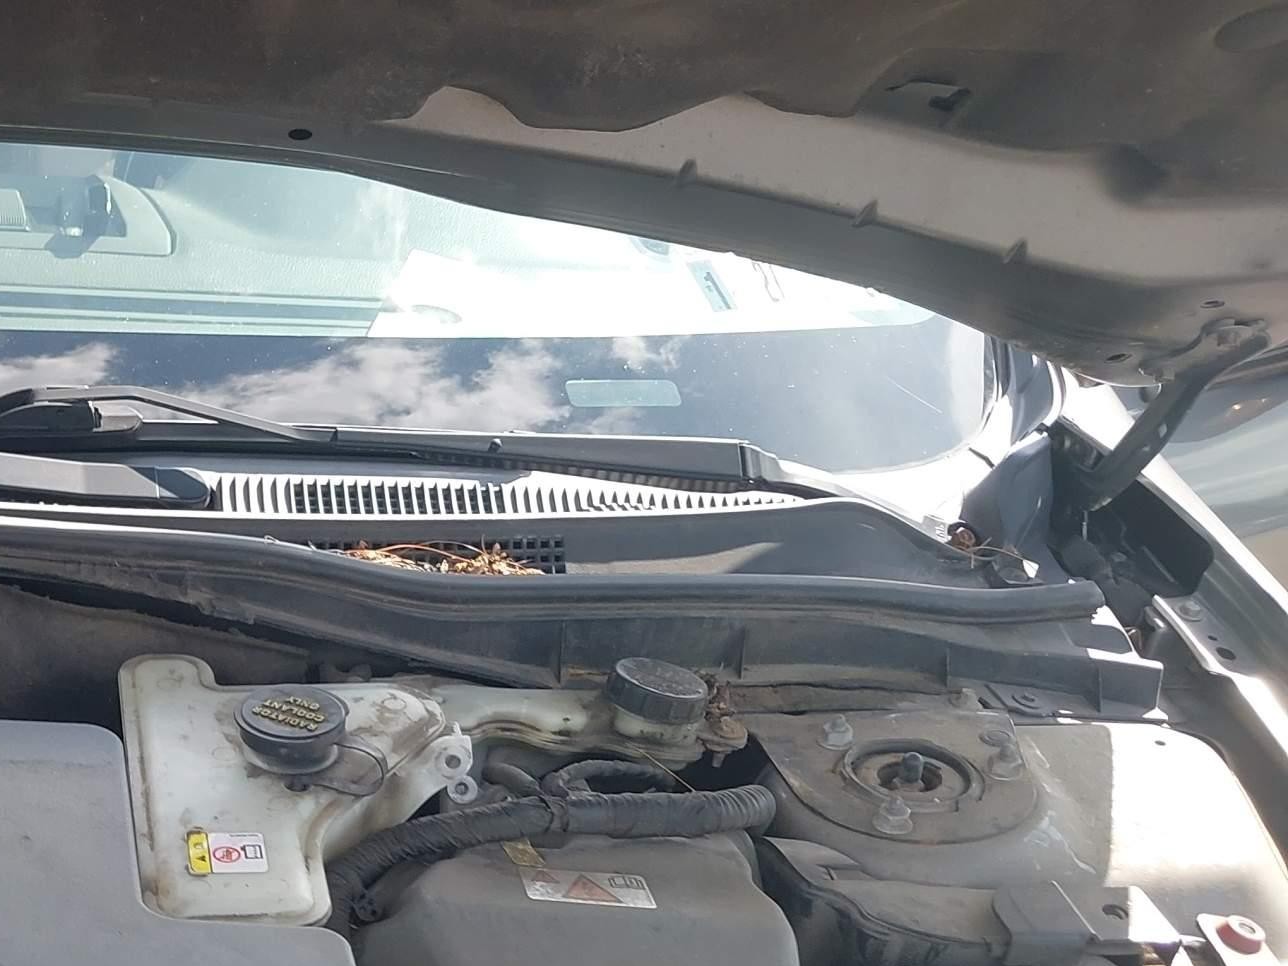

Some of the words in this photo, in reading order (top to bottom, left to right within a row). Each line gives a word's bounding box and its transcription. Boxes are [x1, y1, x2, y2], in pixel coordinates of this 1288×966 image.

[263, 699, 325, 723] COOLANT
[285, 695, 320, 711] ONLY
[252, 705, 318, 732] RADIATOR
